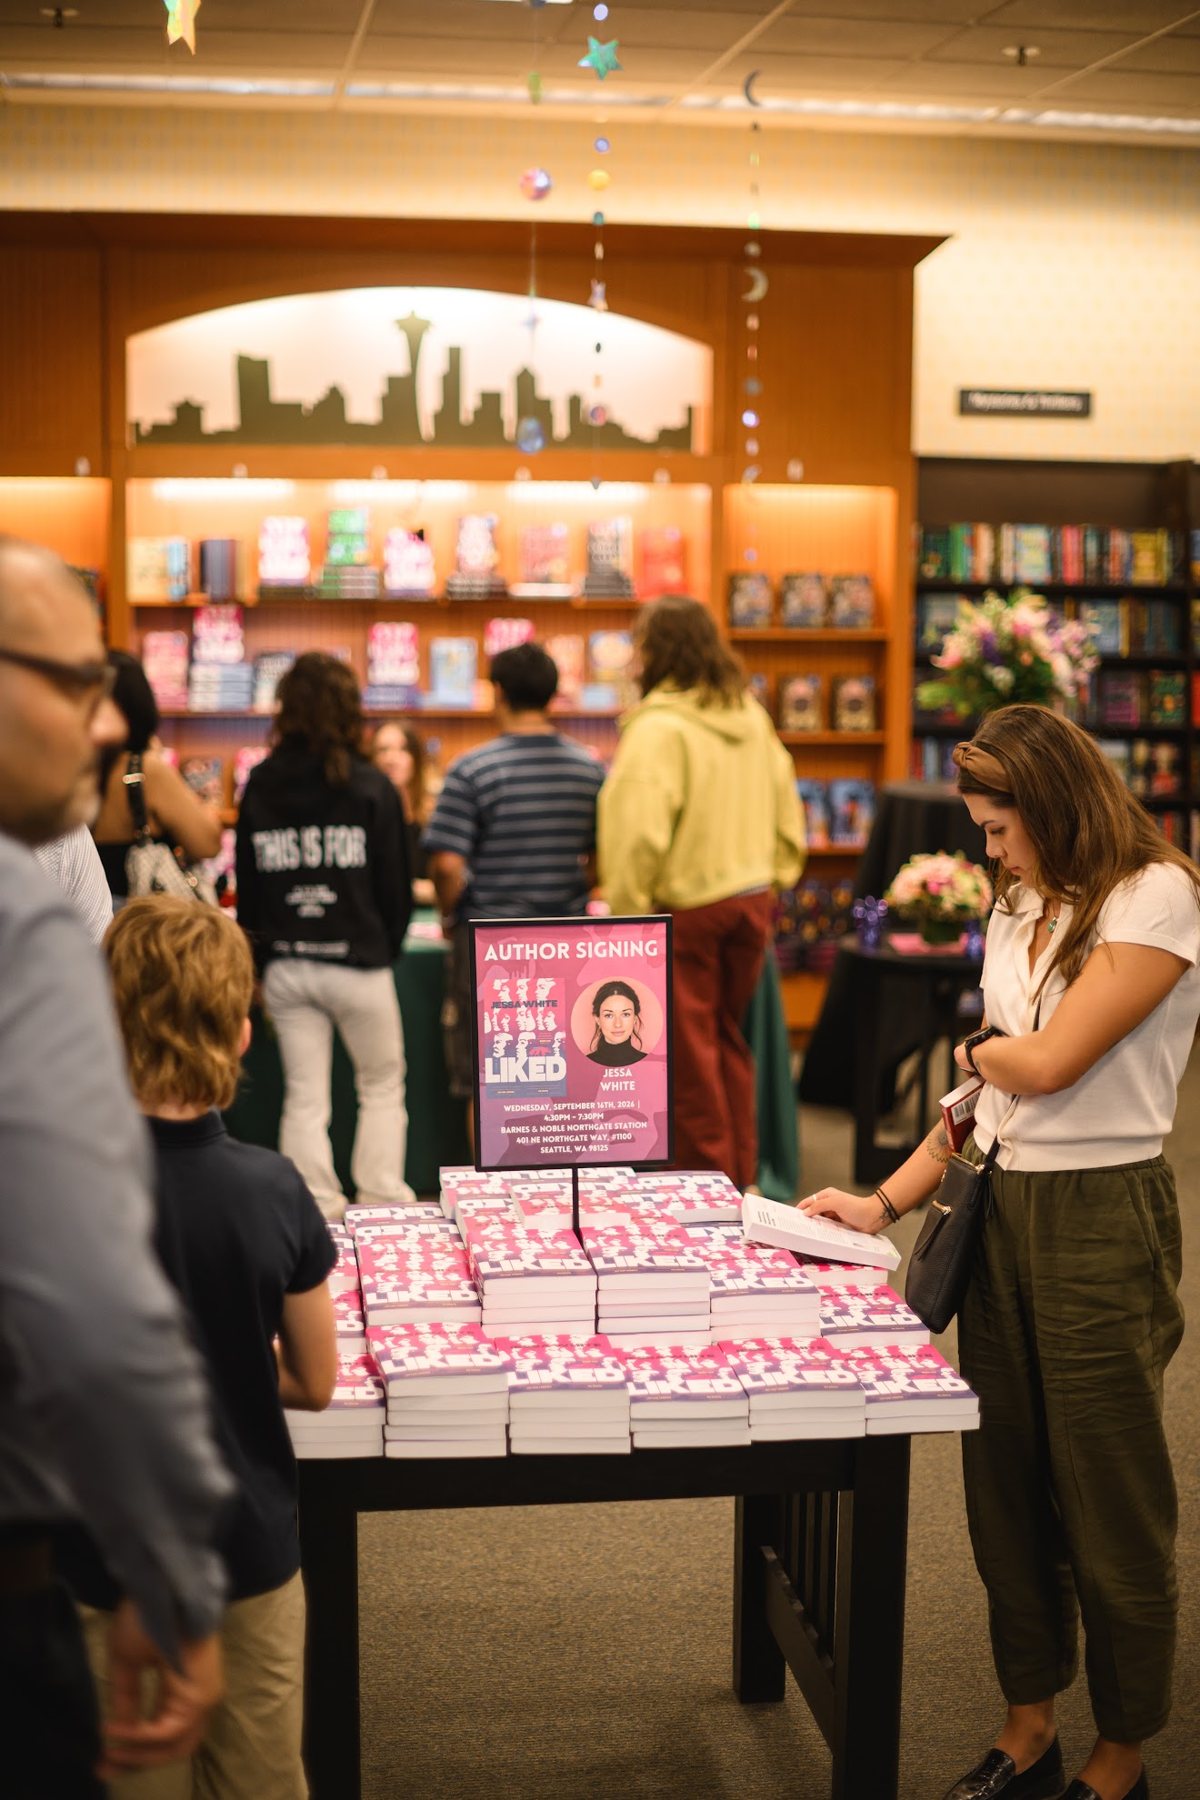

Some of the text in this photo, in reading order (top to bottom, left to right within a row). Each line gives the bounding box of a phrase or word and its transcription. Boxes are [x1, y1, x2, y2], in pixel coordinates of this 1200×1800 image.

[301, 825, 321, 867] IS
[324, 824, 366, 867] FOR
[484, 940, 658, 961] AUTHOR SIGNING
[491, 1000, 558, 1009] JESSA WHITE
[485, 1056, 566, 1083] LIKED
[603, 1068, 633, 1078] JESSA
[600, 1081, 636, 1091] WHITE
[503, 1104, 552, 1112] WEDNESDAY,
[553, 1103, 596, 1111] SEPTEMBER
[578, 1113, 604, 1121] 7:30PM
[500, 1121, 648, 1134] BARNES & NOBLE NORTHGATE STATION
[516, 1136, 529, 1144] 401
[530, 1135, 541, 1143] NE
[542, 1134, 588, 1143] NORTHGATE
[590, 1133, 610, 1142] WAY,
[540, 1146, 573, 1154] SEATTLE,
[479, 1258, 593, 1274] LIKED
[592, 1255, 707, 1269] LIKED
[365, 1290, 478, 1305] LIKED
[380, 1353, 502, 1375] LIKED
[507, 1368, 625, 1386] LIKED
[739, 1370, 859, 1389] LIKED
[626, 1380, 744, 1396] LIKED
